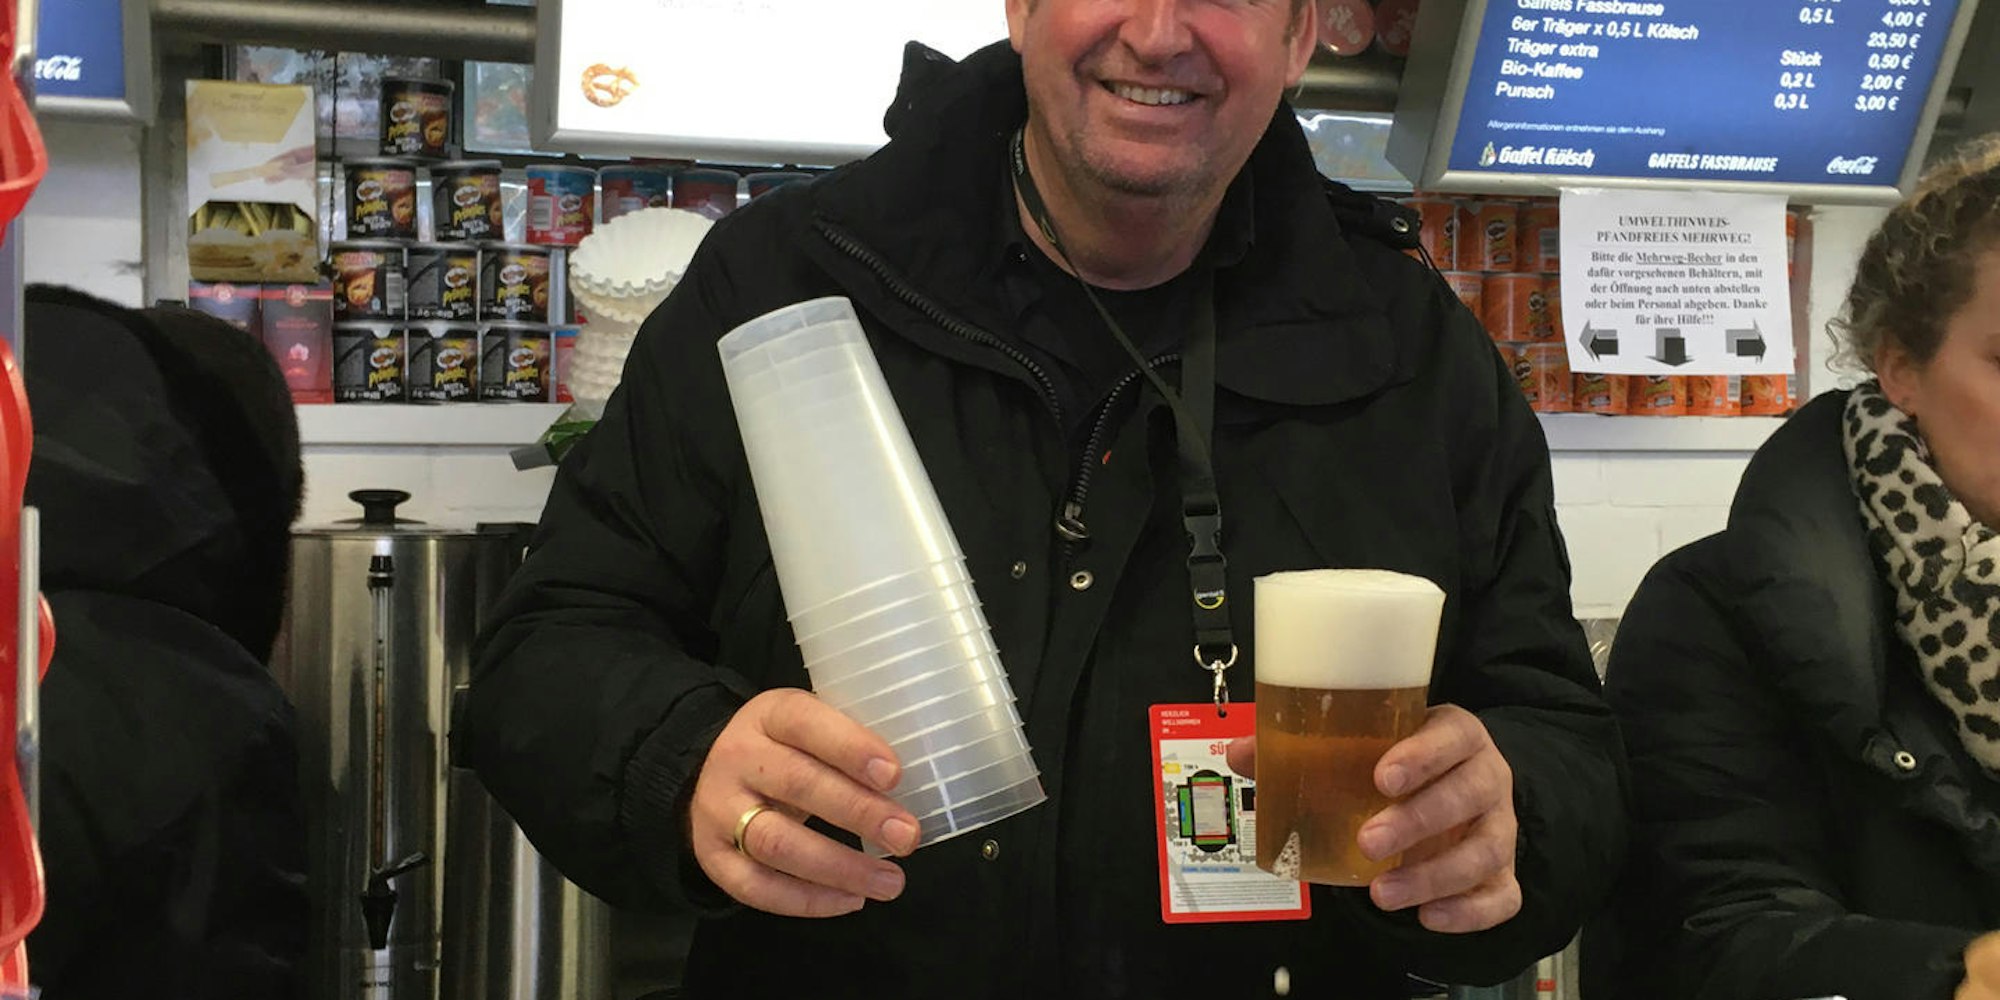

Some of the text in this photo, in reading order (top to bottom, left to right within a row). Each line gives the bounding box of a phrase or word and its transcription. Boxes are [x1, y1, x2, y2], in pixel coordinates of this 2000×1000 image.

[1576, 0, 1665, 16] Fassbrause
[1799, 7, 1834, 25] 0,5 L
[1881, 11, 1927, 28] 4,00 €
[1511, 16, 1700, 41] 6er Träger x 0,5 L Kölsch
[1507, 37, 1600, 59] Träger extra
[1867, 32, 1921, 50] 23,50 €
[1780, 50, 1823, 67] Stück
[1868, 53, 1913, 71] 0,50 €
[1500, 59, 1584, 80] Bio-Kaffee
[1780, 72, 1815, 89] 0,2 L
[1860, 74, 1906, 91] 2,00 €
[1495, 81, 1555, 100] Punsch
[1774, 93, 1809, 110] 0,3 L
[1855, 95, 1899, 112] 3,00 €
[1499, 145, 1596, 169] Gaffel Kölsch
[1648, 152, 1778, 172] GAFFELS FASSBRAUSE
[1619, 215, 1730, 228] UMWELTHINWEIS-
[1597, 230, 1752, 244] PFANDFREIES MEHRWEG!
[1591, 251, 1758, 265] Bitte die Mehrweg-Becher in den
[1587, 266, 1763, 280] dafür vorgesehenen Behältern, mit
[1590, 280, 1761, 296] der Öffnung nach unten abstellen
[1584, 299, 1768, 311] oder beim Personal abgeben. Danke
[1635, 314, 1714, 325] für ihre Hilfe!!!
